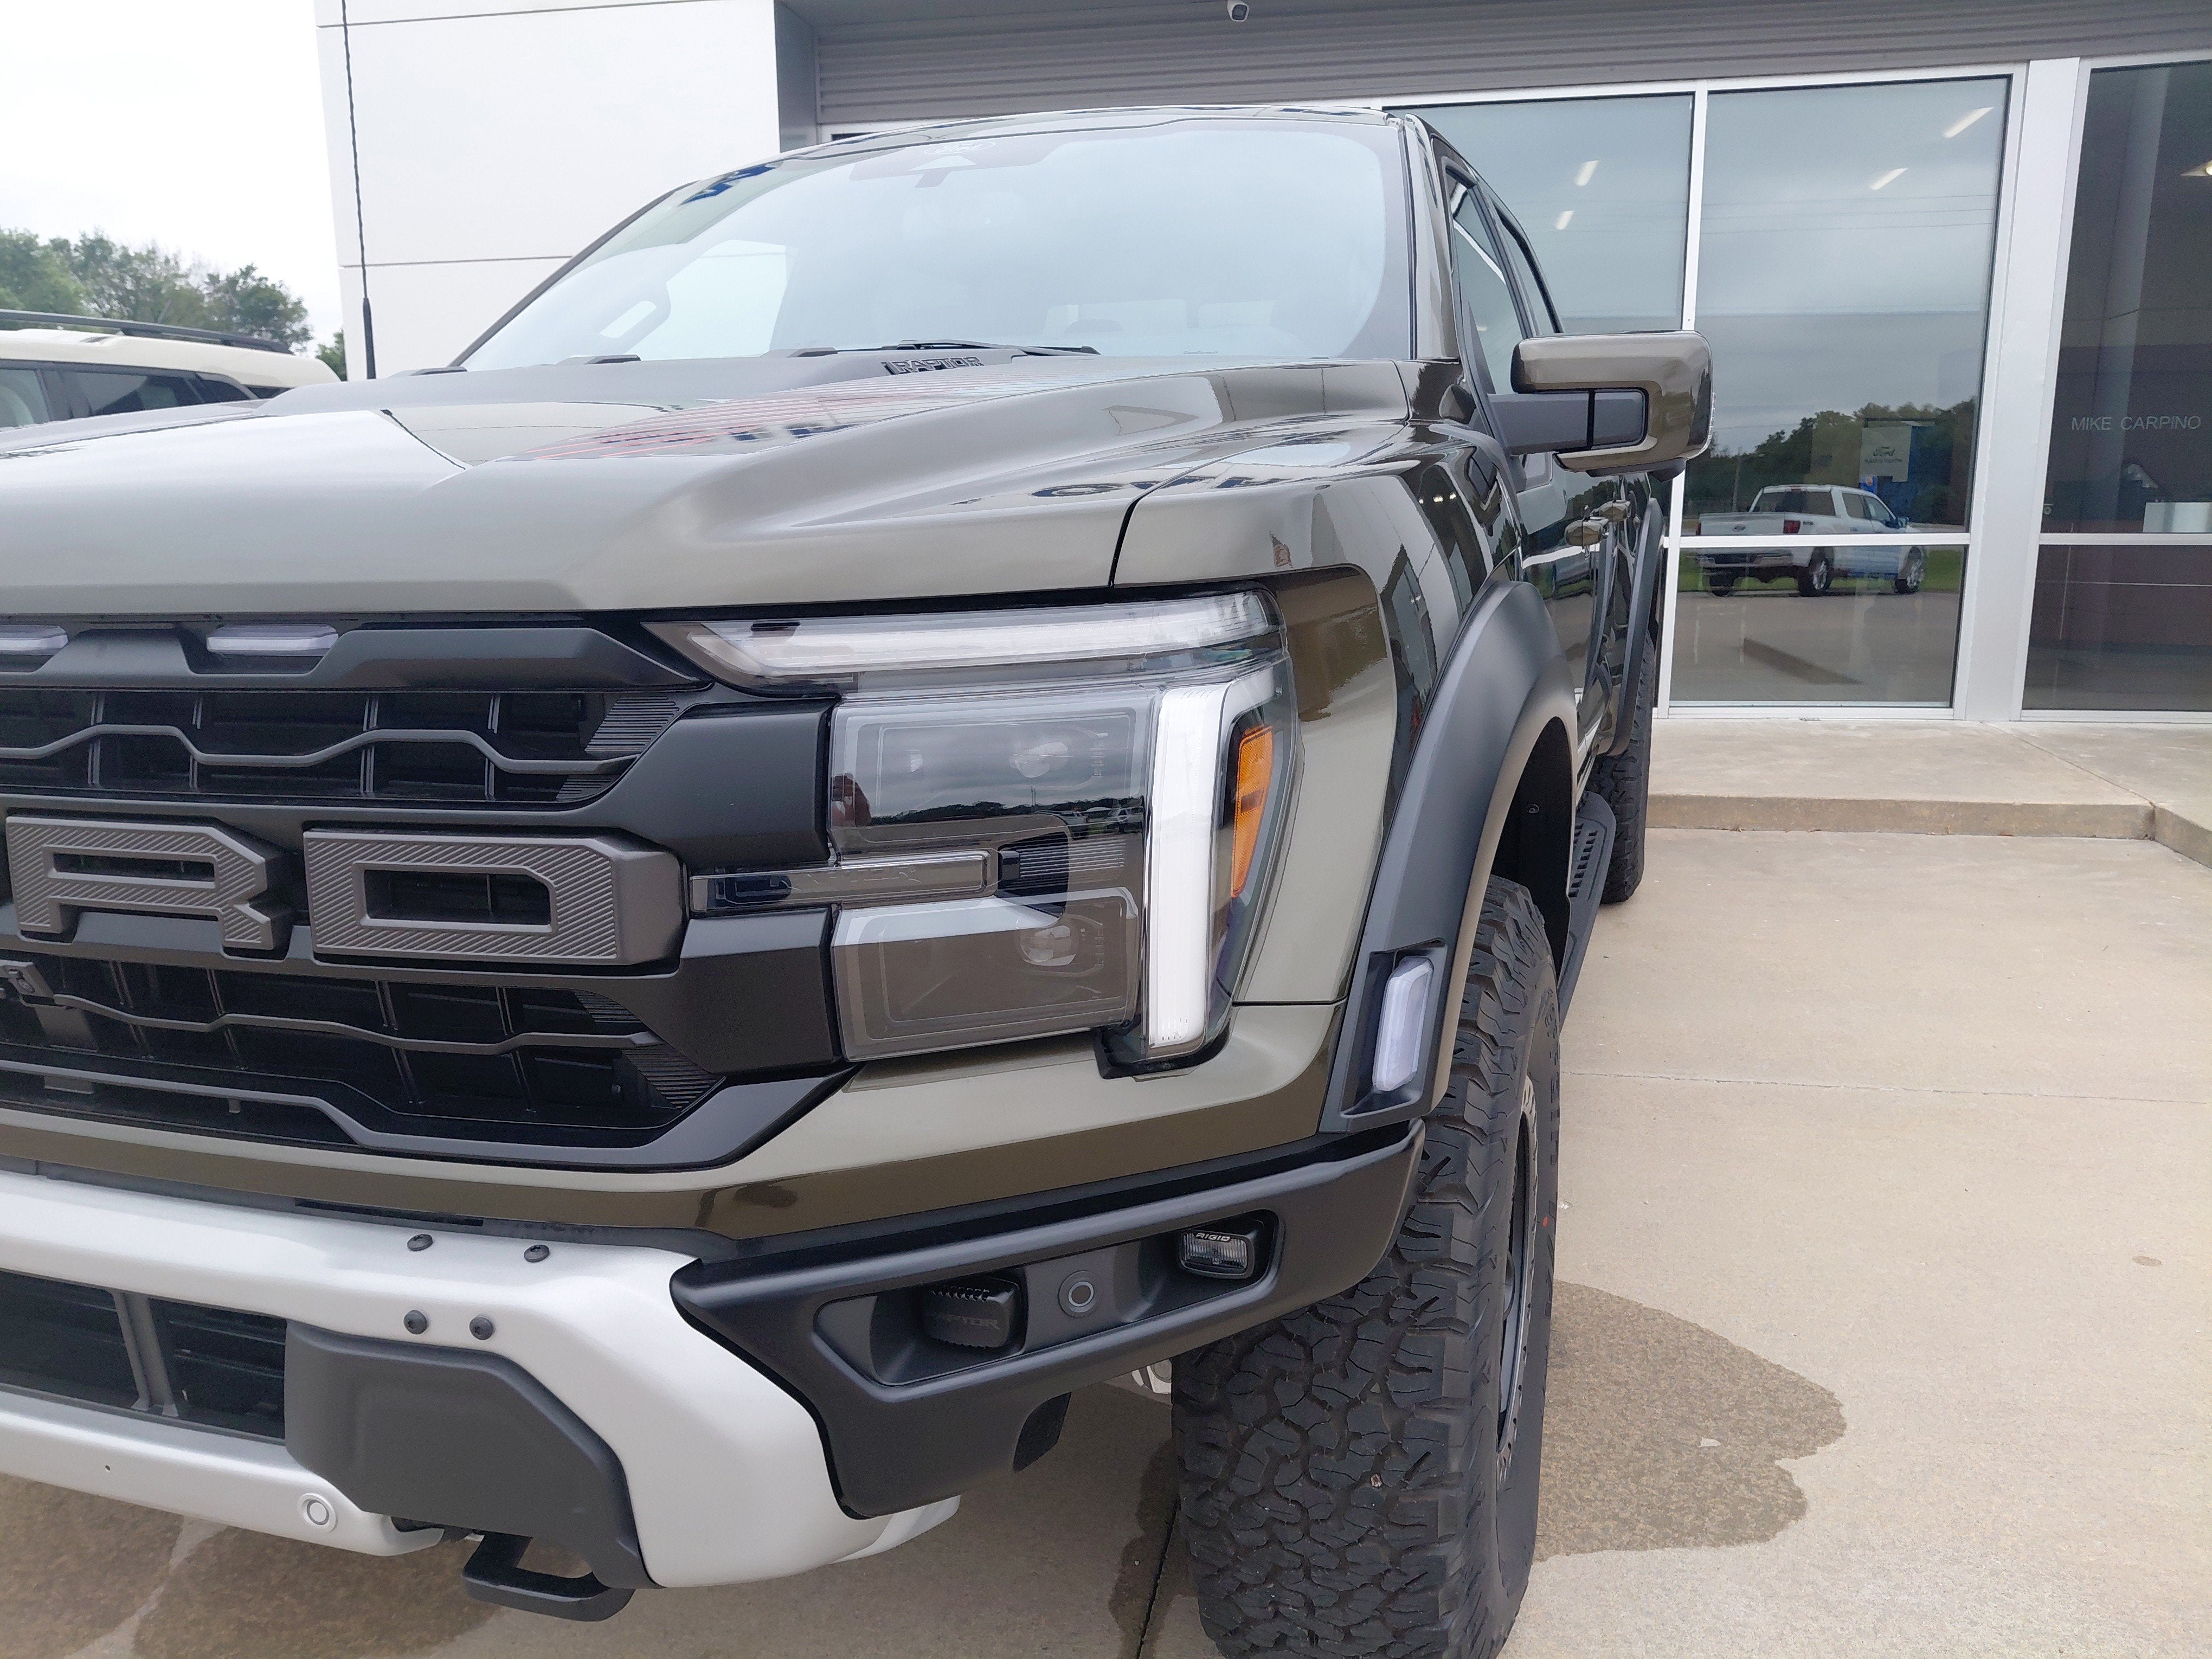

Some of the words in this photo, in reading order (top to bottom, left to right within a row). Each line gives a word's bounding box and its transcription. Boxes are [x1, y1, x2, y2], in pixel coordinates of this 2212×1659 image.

[880, 356, 985, 375] RAPTOR
[2071, 416, 2112, 430] MIKE
[2120, 415, 2201, 430] CARPINO
[1195, 1232, 1231, 1242] RIGID
